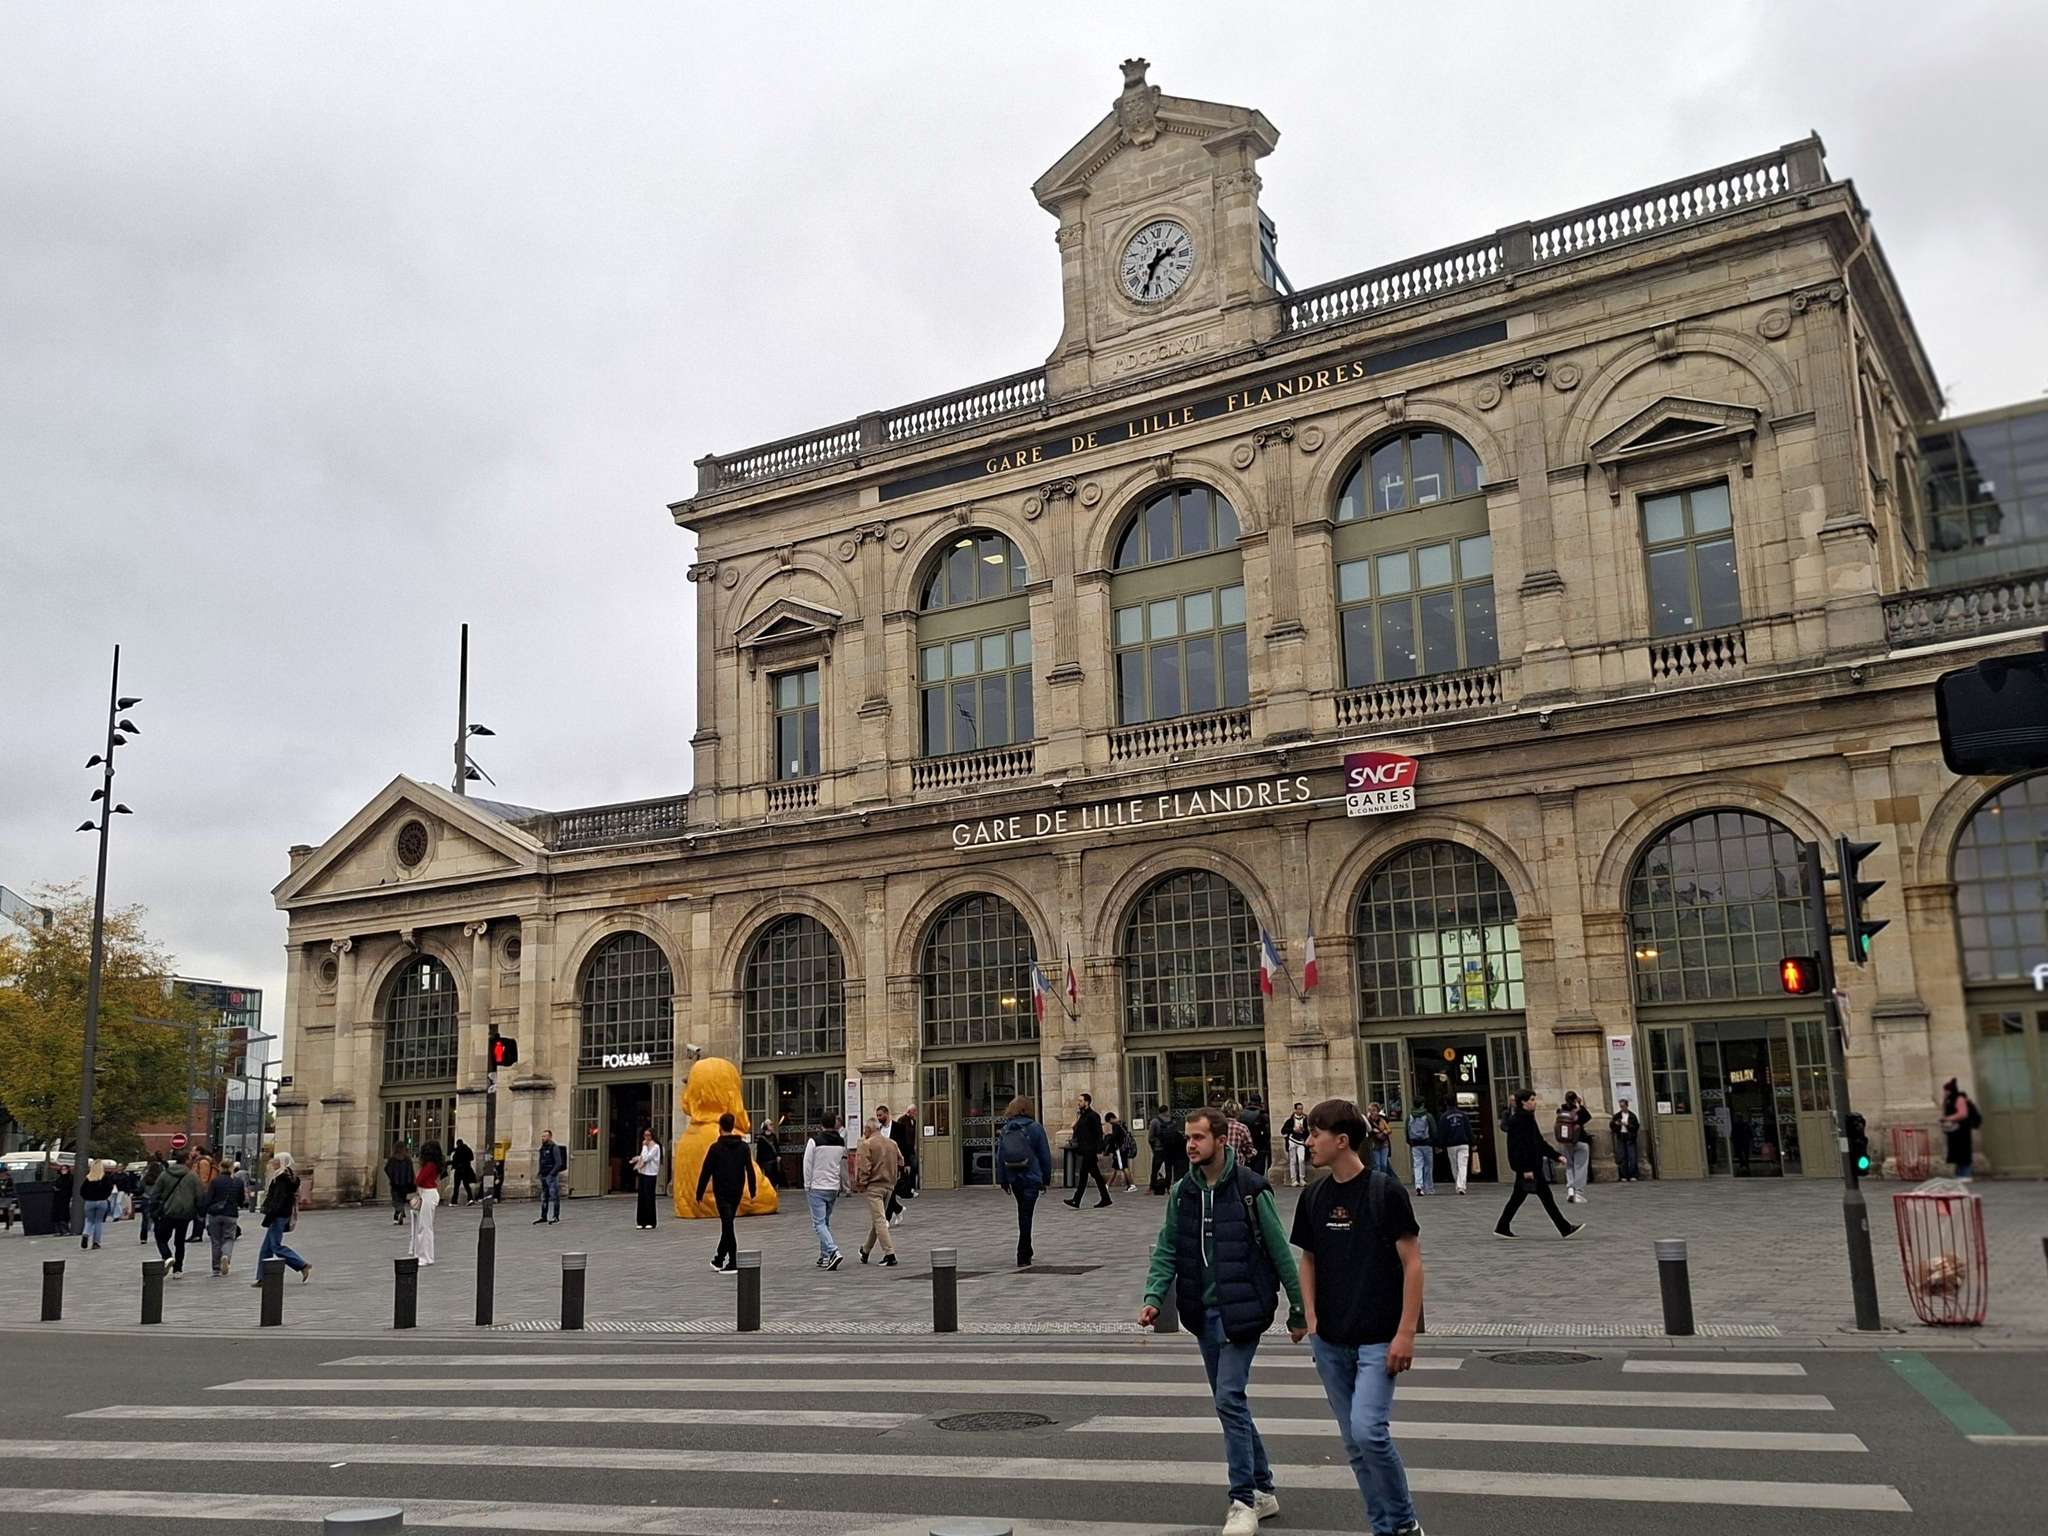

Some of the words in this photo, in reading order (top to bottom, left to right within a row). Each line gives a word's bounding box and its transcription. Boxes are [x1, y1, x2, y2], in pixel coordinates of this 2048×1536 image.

[985, 446, 1043, 474] GARE
[1071, 432, 1098, 453] DE
[1128, 406, 1195, 438] LILLE
[1227, 361, 1364, 412] FLANDRES
[1348, 761, 1411, 788] SNCF
[952, 816, 1022, 846] GARE
[1036, 810, 1068, 836] DE
[1082, 800, 1144, 830] LILLE
[1158, 776, 1311, 820] FLANDRES
[1348, 789, 1411, 808] GARES
[602, 1052, 651, 1068] POKAWA
